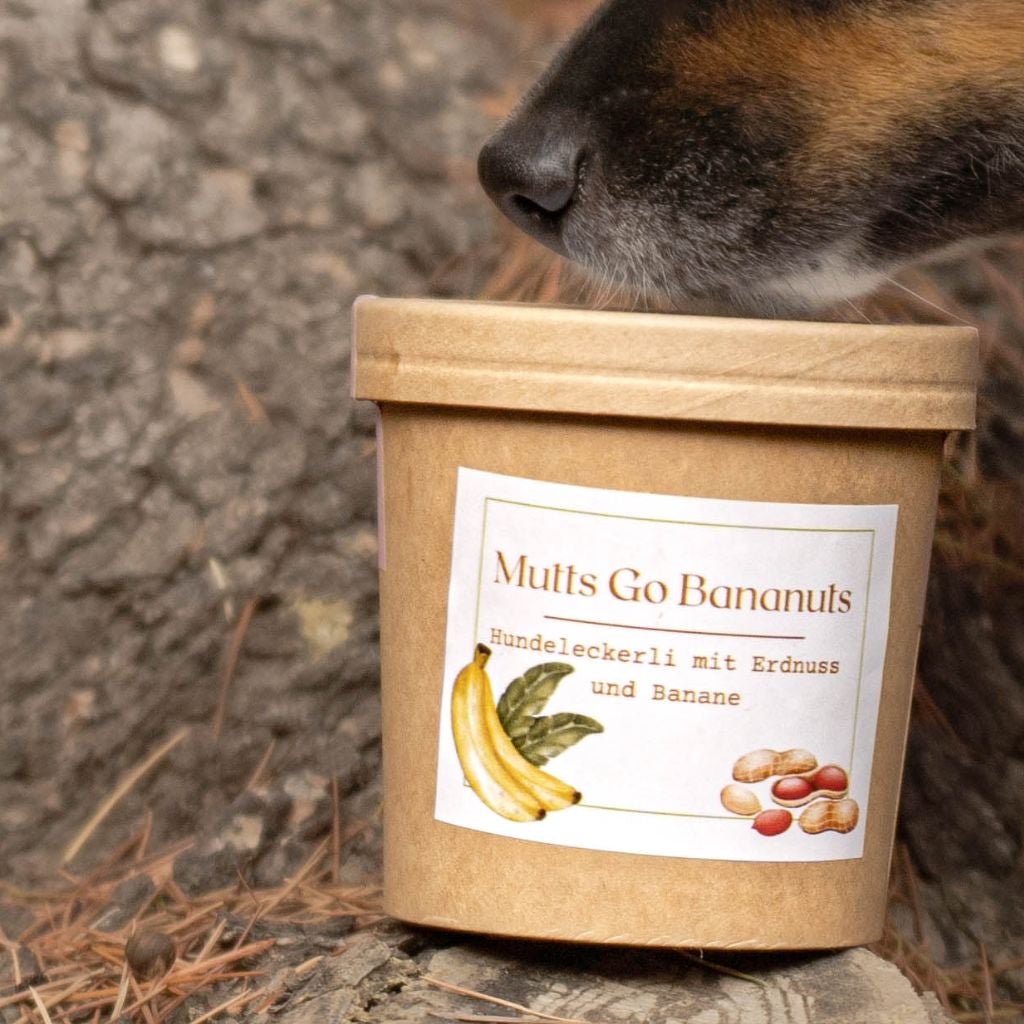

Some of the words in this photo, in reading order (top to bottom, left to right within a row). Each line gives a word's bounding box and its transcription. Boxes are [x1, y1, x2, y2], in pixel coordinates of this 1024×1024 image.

[493, 550, 599, 597] Mutts
[608, 567, 671, 605] Go
[678, 573, 853, 615] Bananuts
[489, 627, 676, 668] Hundeleckerli
[692, 655, 737, 672] mit
[751, 655, 840, 675] Erdnuss
[591, 679, 636, 699] und
[652, 683, 742, 707] Banane
